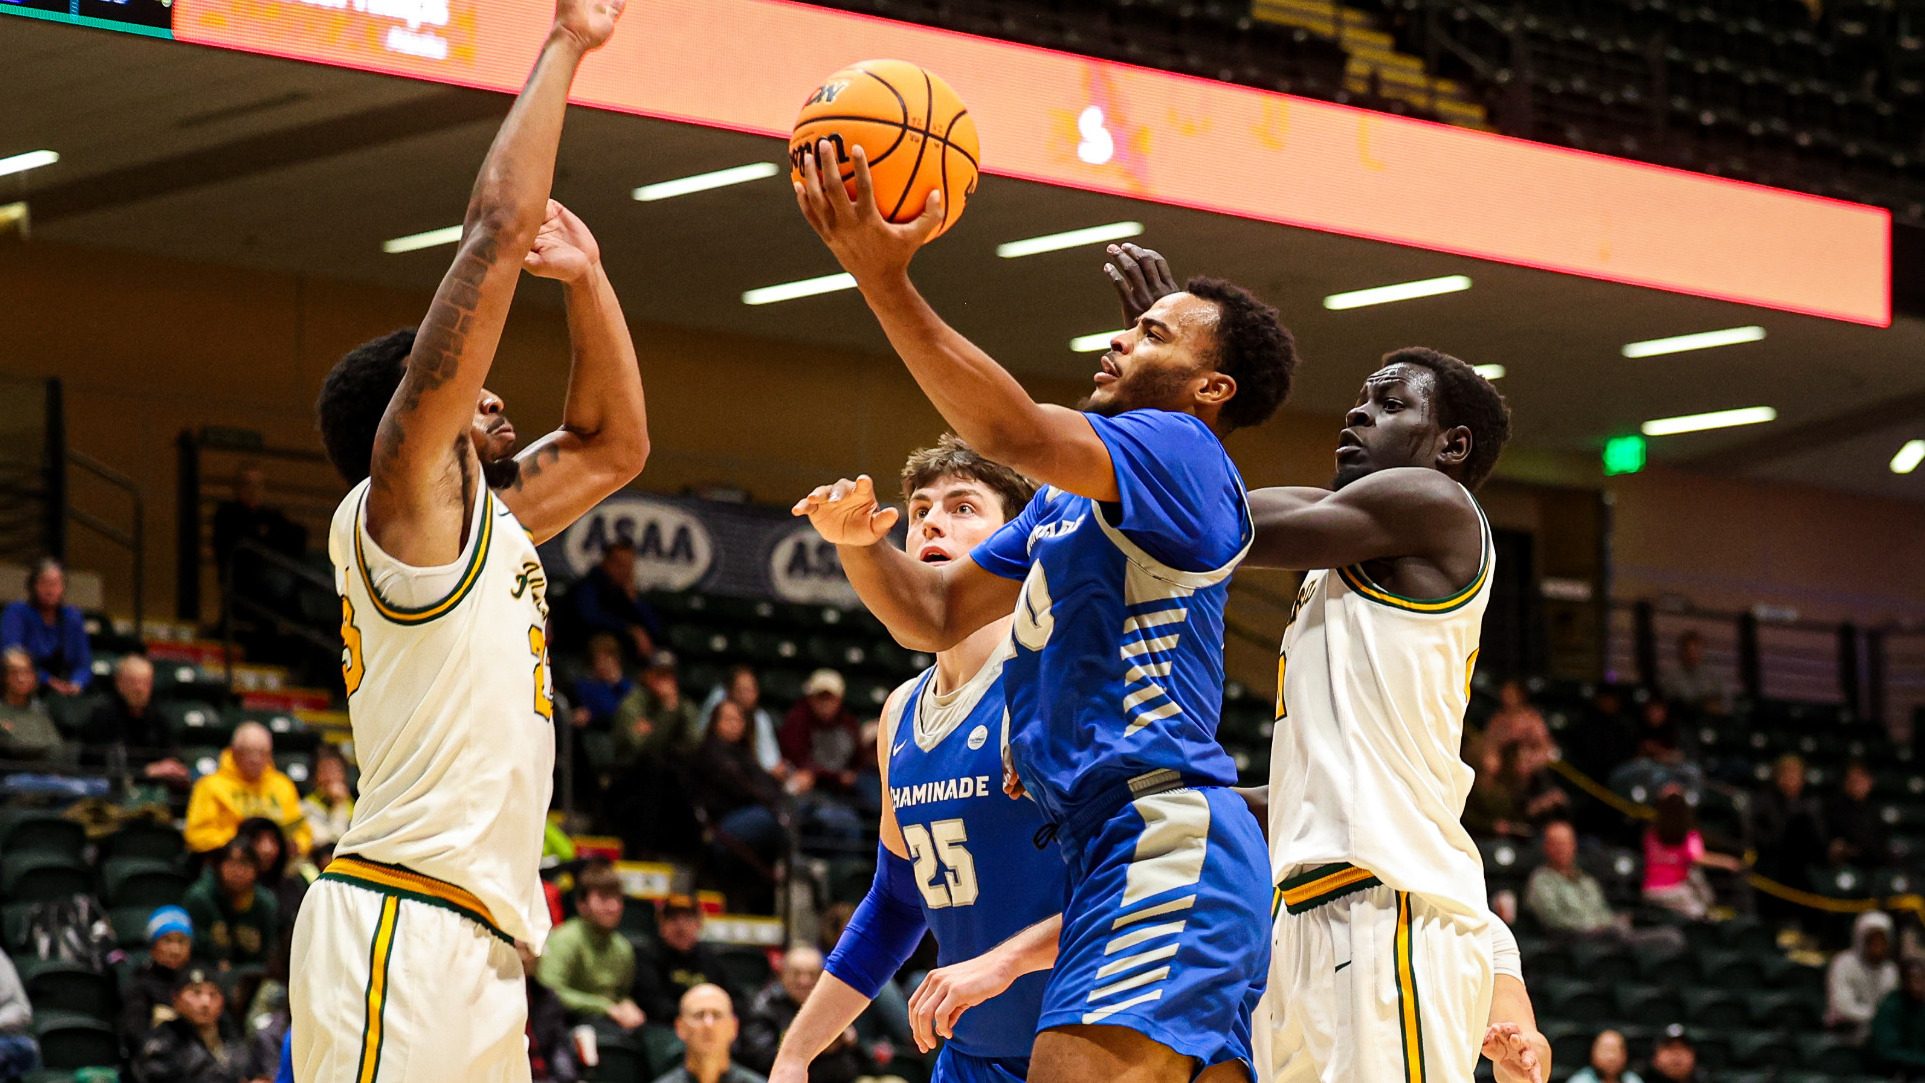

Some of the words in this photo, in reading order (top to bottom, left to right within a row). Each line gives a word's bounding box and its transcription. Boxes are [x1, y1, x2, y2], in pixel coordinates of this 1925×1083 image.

[583, 514, 695, 564] ASAA
[786, 540, 846, 580] AS
[527, 623, 554, 723] 2
[890, 775, 990, 813] HAMINADE
[902, 817, 979, 909] 25
